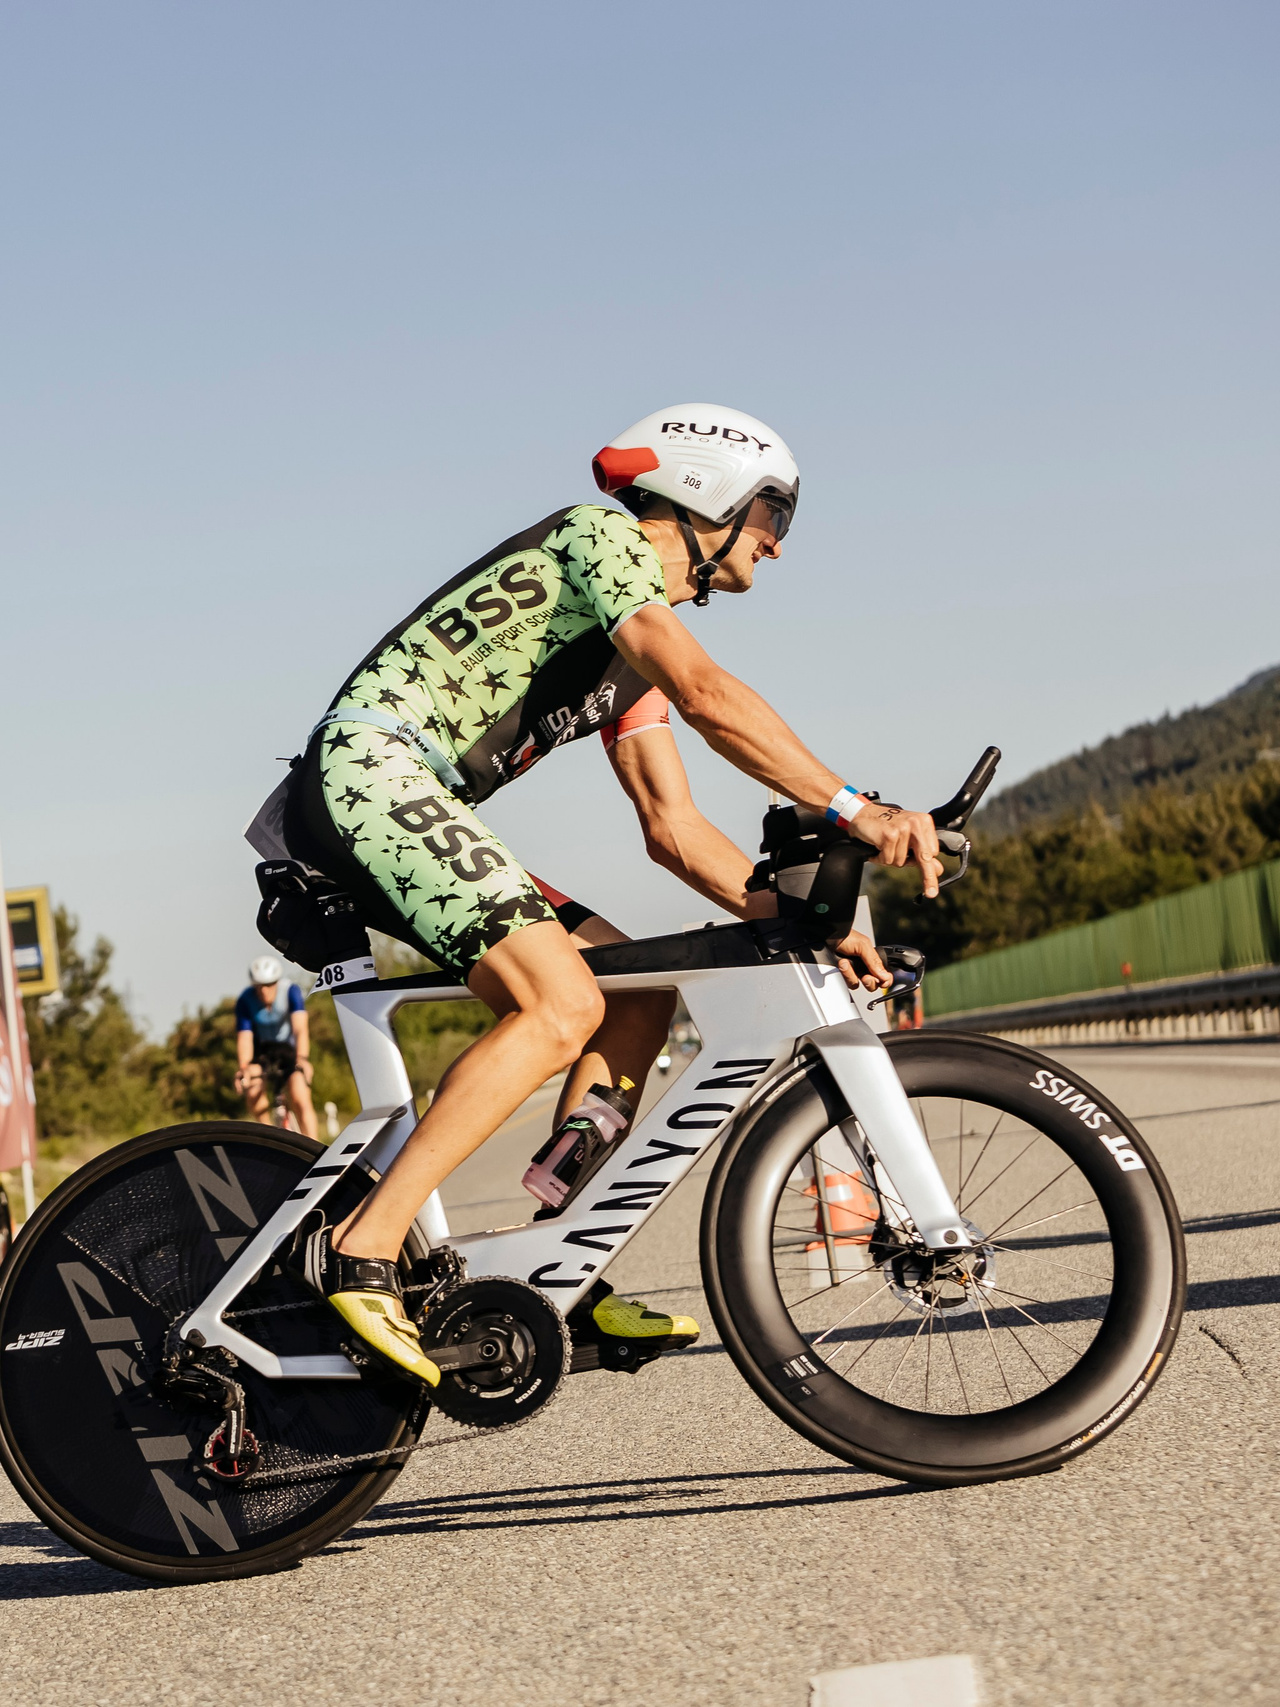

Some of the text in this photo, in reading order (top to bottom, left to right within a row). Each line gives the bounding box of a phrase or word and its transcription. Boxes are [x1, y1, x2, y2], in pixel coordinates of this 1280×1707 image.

[661, 422, 772, 451] RUDY
[668, 435, 763, 457] PROJECT
[683, 475, 702, 489] 308
[425, 561, 548, 656] BSS
[460, 643, 496, 673] BAUER
[490, 622, 528, 648] SPORT
[387, 796, 507, 882] BSS
[315, 965, 344, 988] 308
[1029, 1070, 1146, 1171] DT SWISS
[528, 1058, 776, 1288] CANYON
[5, 1335, 63, 1351] ZIPP
[18, 1329, 66, 1340] SUPER-9
[515, 1378, 542, 1404] ROTOR
